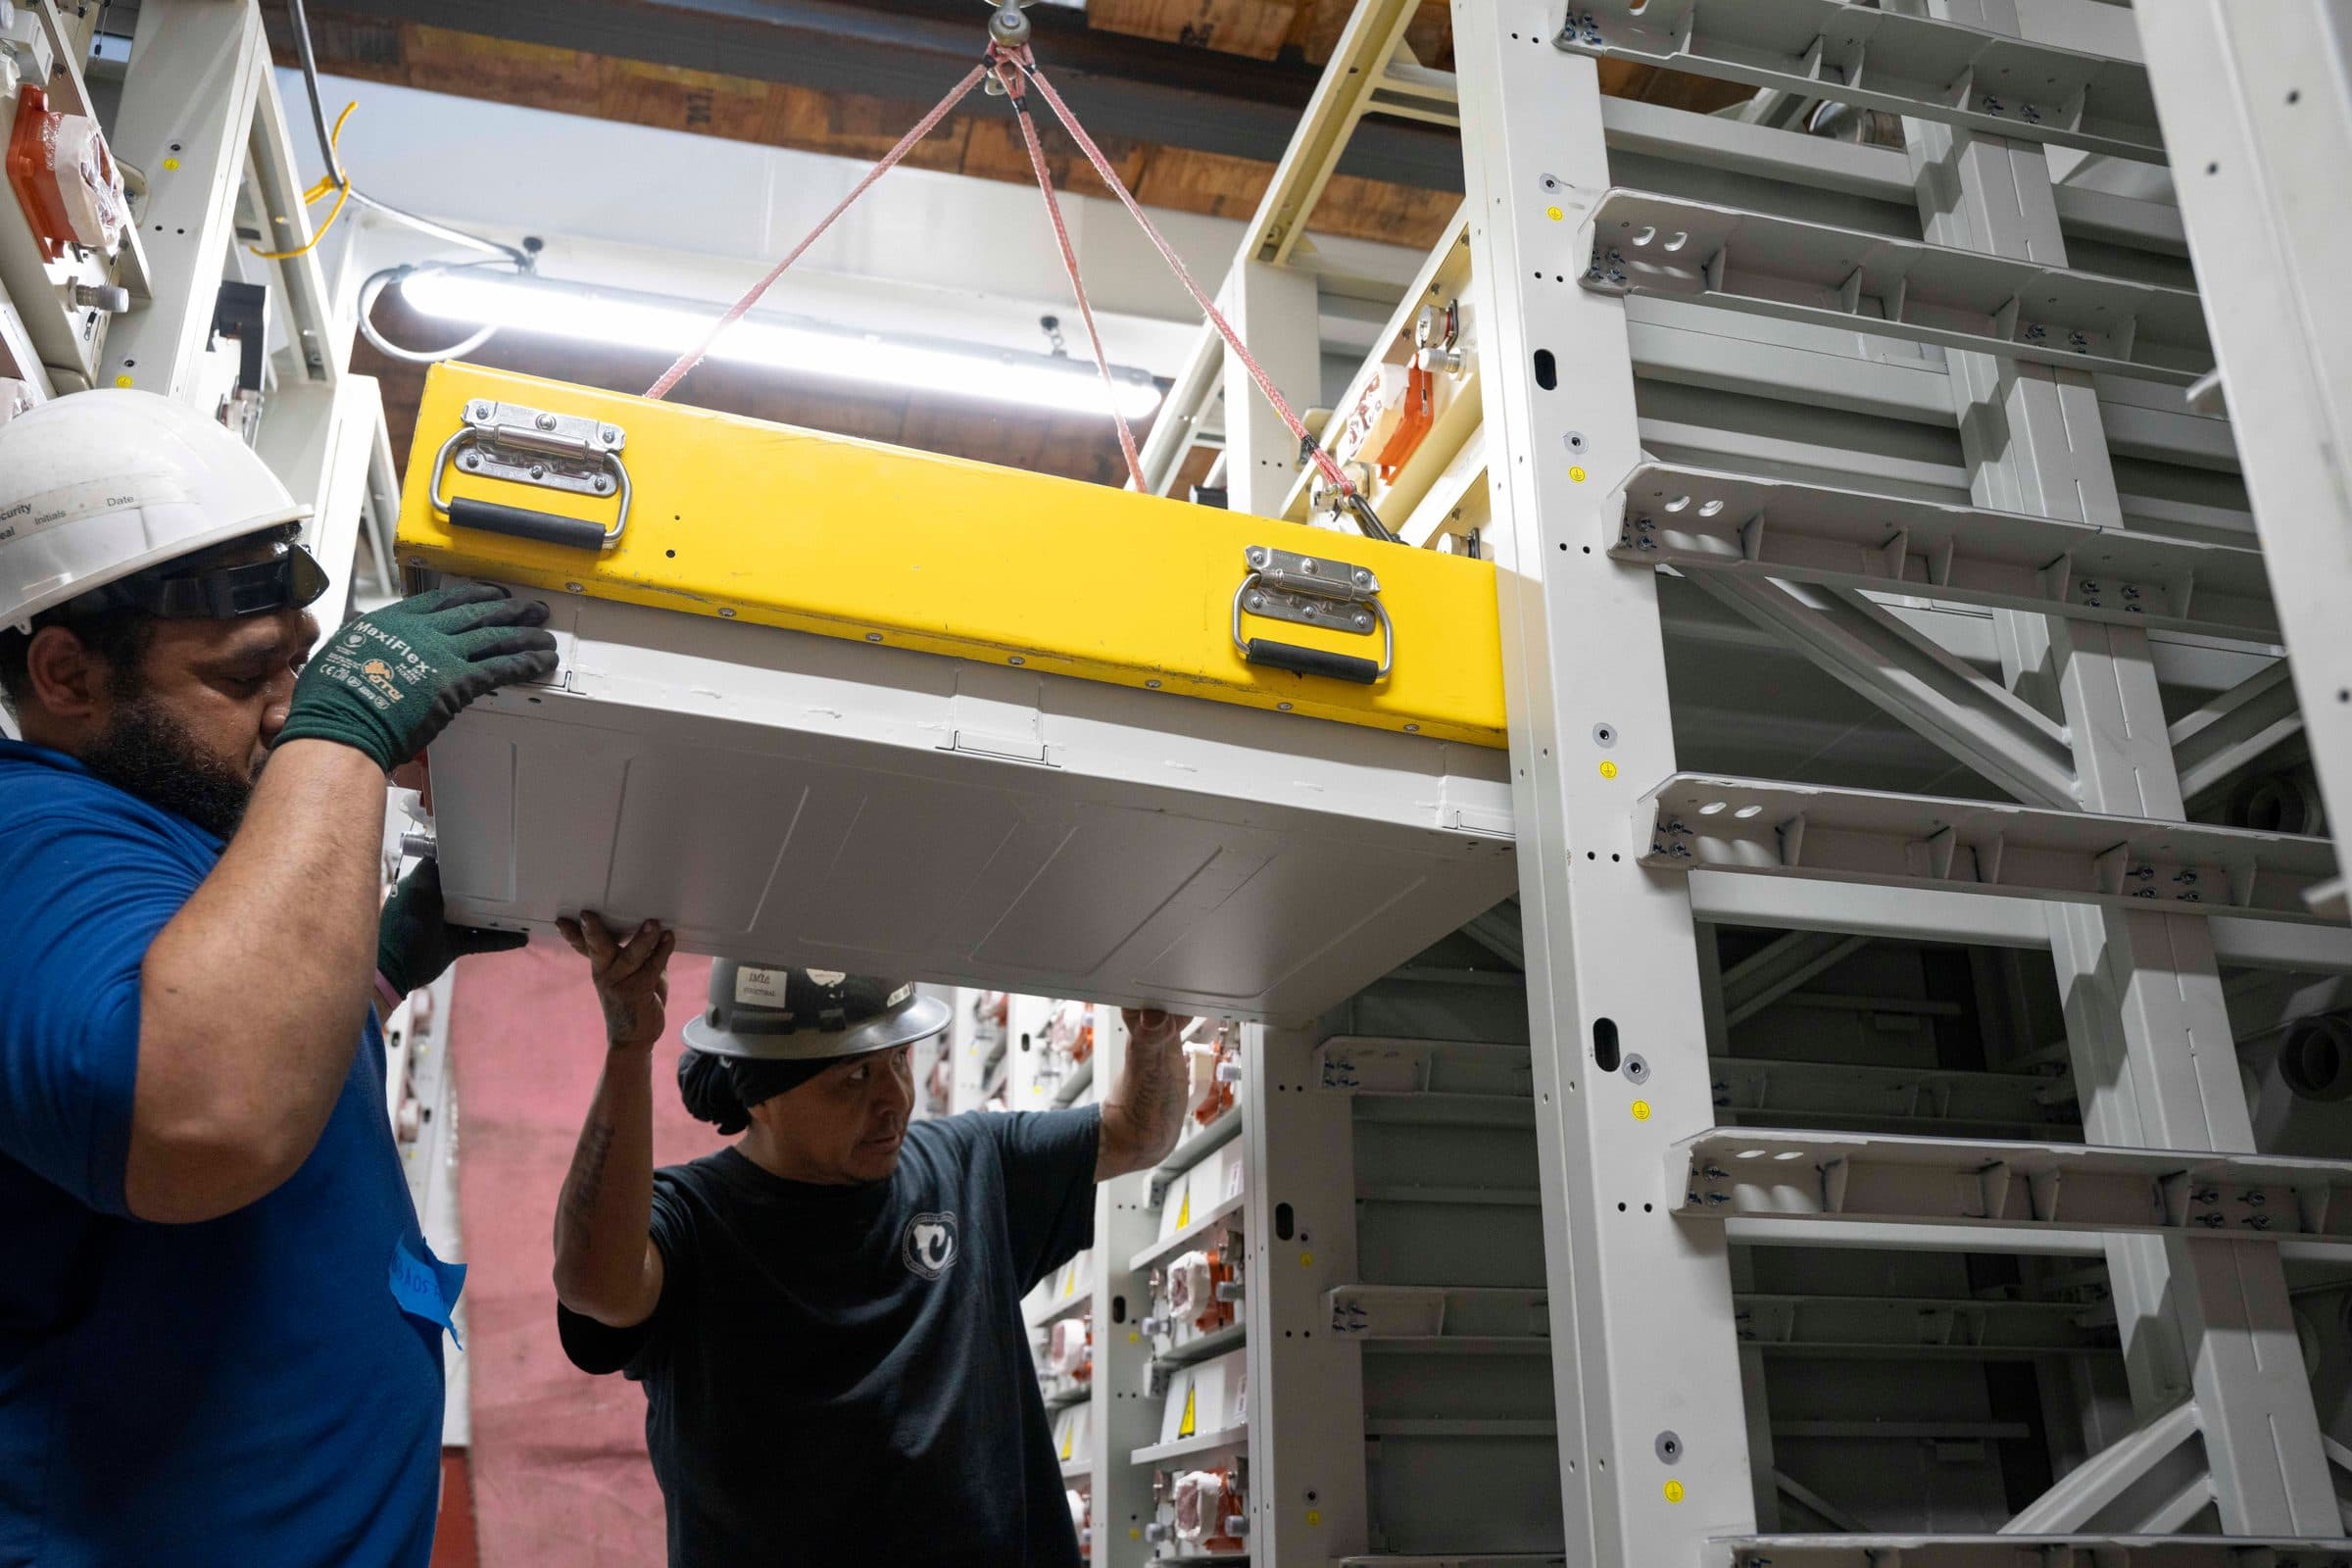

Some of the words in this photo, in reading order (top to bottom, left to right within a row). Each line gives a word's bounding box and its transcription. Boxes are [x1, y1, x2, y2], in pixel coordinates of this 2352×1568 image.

[0, 503, 31, 520] curity
[34, 510, 67, 525] Initials
[106, 496, 134, 507] Date
